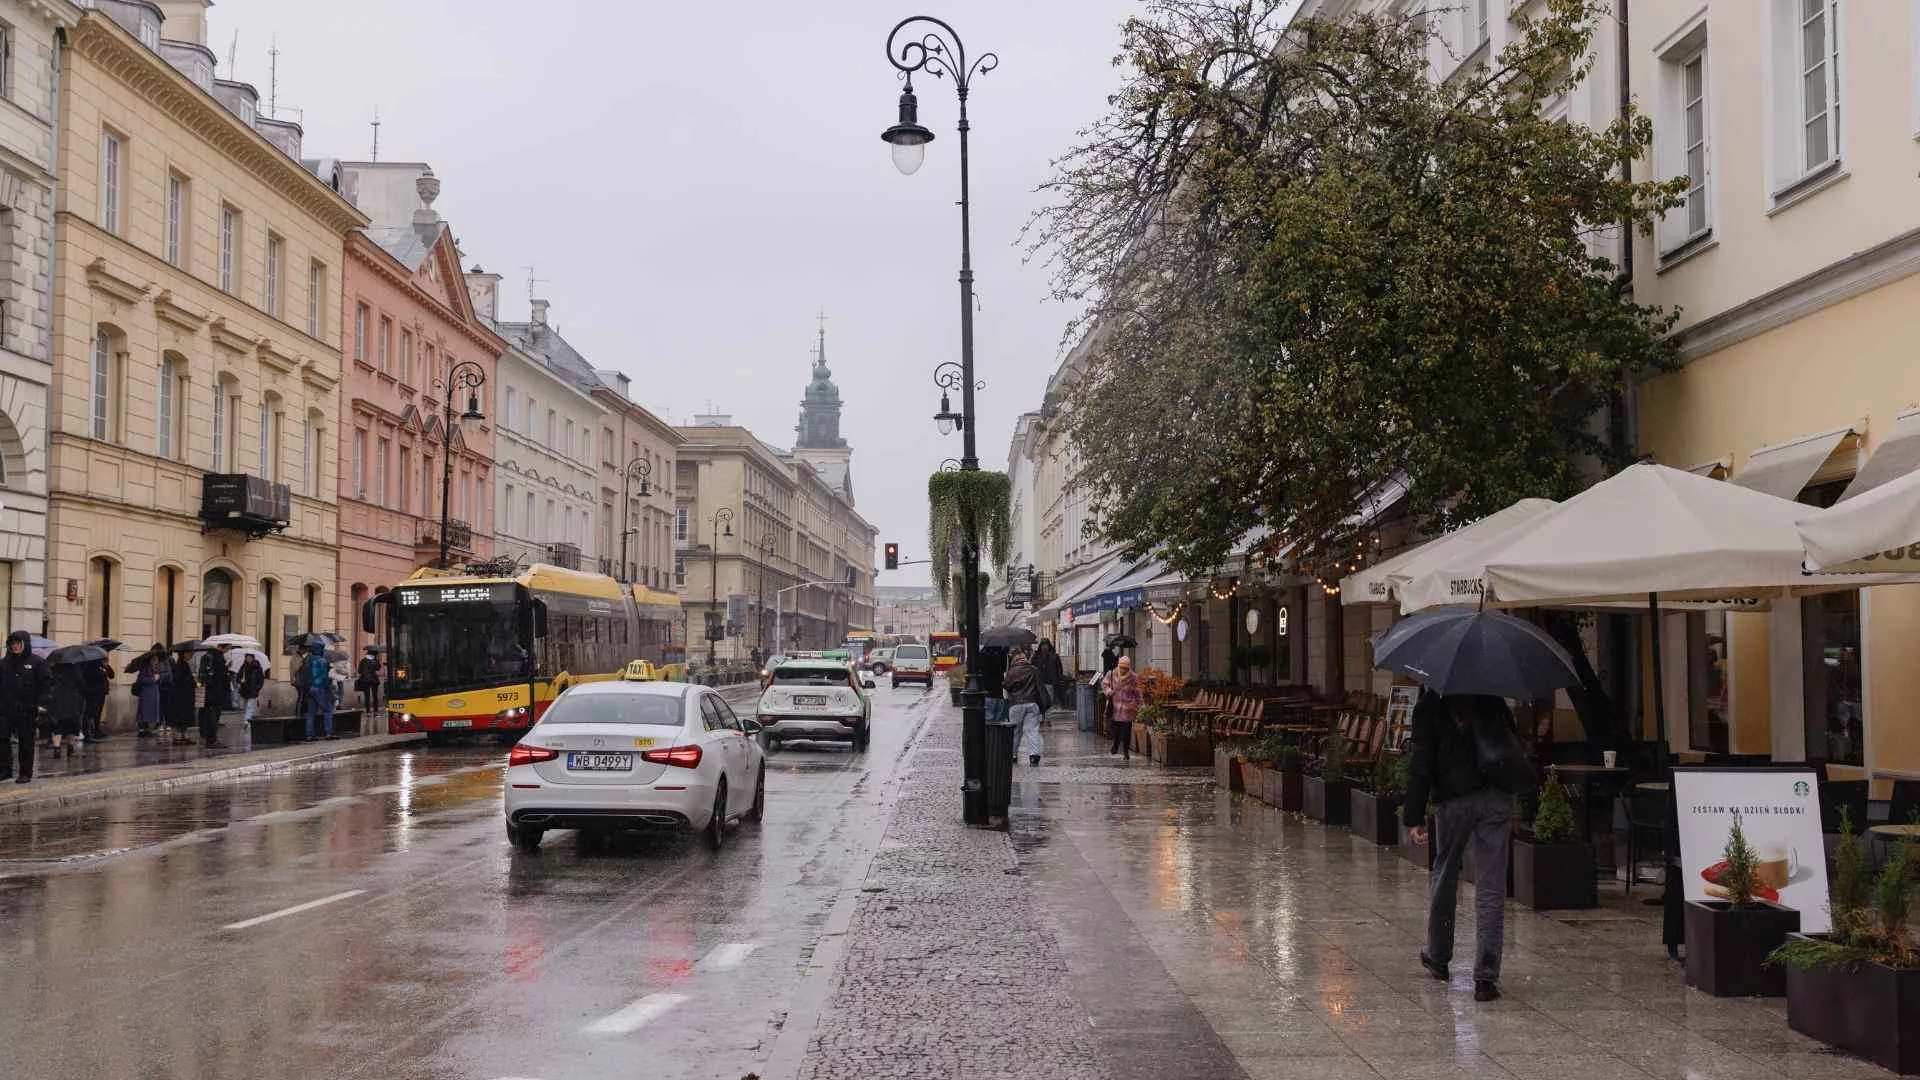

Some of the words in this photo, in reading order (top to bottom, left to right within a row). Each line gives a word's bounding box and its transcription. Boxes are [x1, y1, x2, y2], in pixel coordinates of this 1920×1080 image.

[1450, 578, 1484, 596] STARBUCKS
[629, 663, 645, 675] TAXI
[496, 692, 519, 702] 5973
[576, 755, 589, 767] WB
[594, 755, 629, 767] 0499Y
[1692, 806, 1725, 814] ZESTAW
